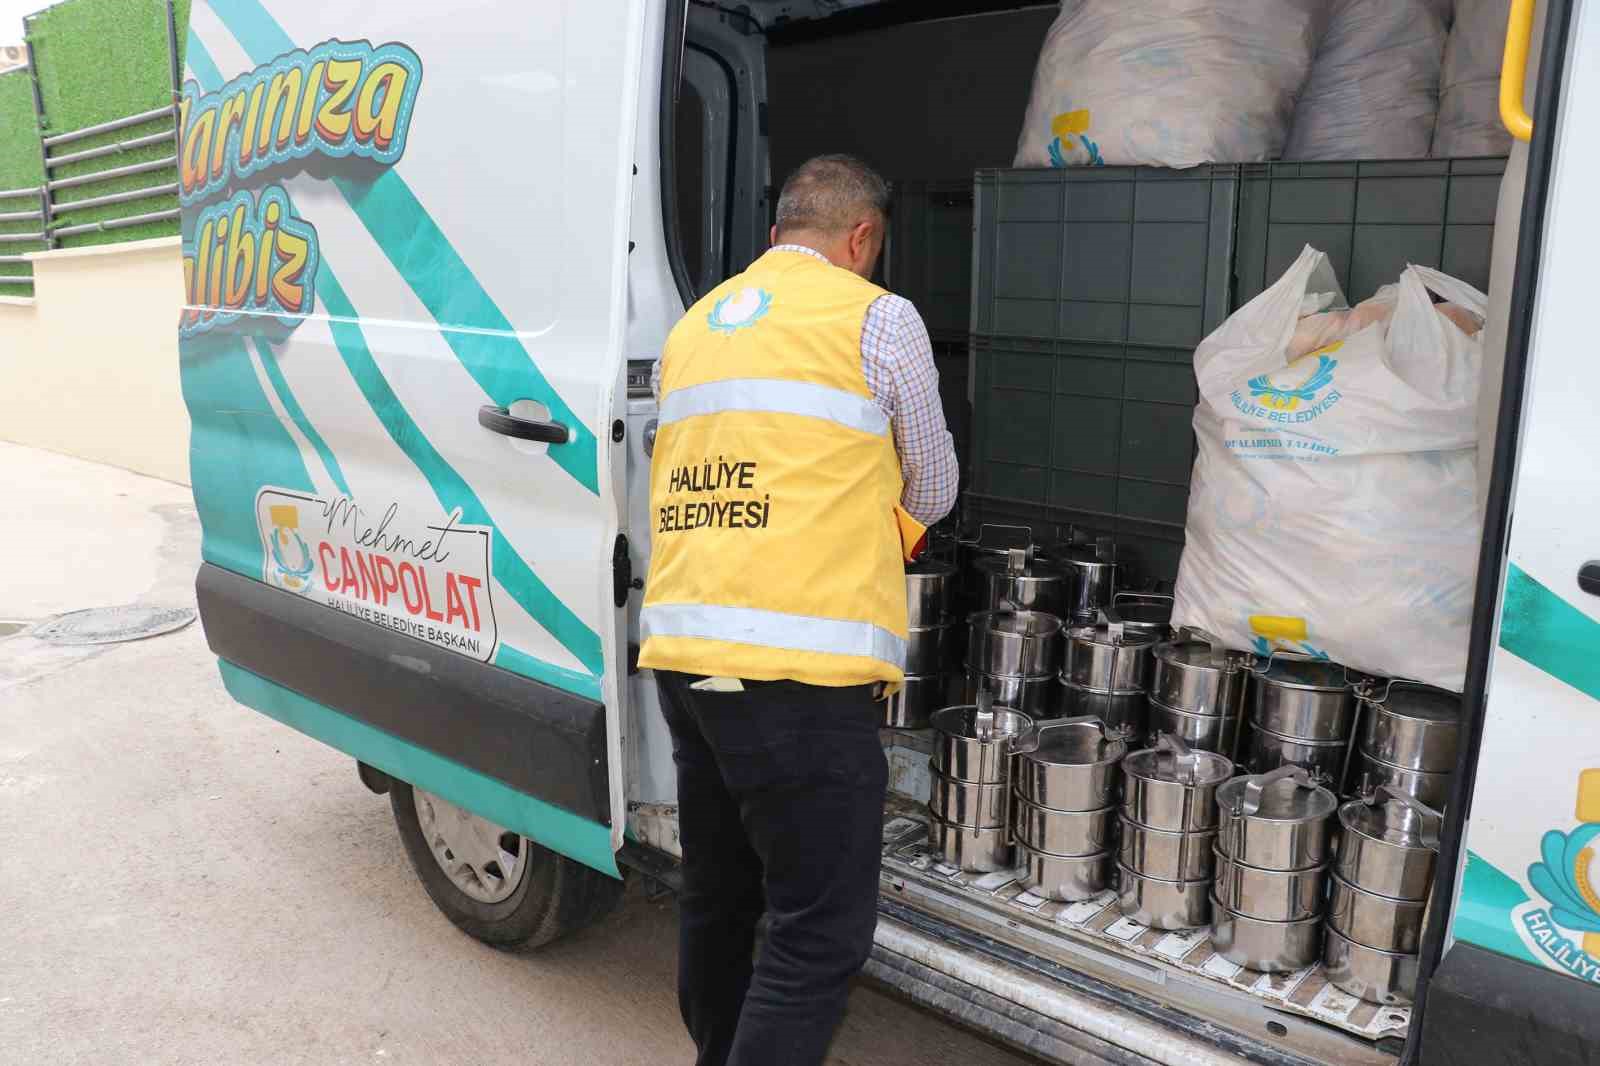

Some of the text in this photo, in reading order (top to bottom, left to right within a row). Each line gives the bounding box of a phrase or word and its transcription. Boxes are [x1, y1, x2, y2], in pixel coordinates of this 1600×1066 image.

[669, 455, 757, 493] HALİLİYE
[322, 496, 464, 563] Mehmet
[658, 493, 770, 533] BELEDİYESİ
[318, 541, 482, 633] CANPOLAT
[374, 611, 425, 638] BELEDİYE
[428, 629, 480, 654] BAŞKANI
